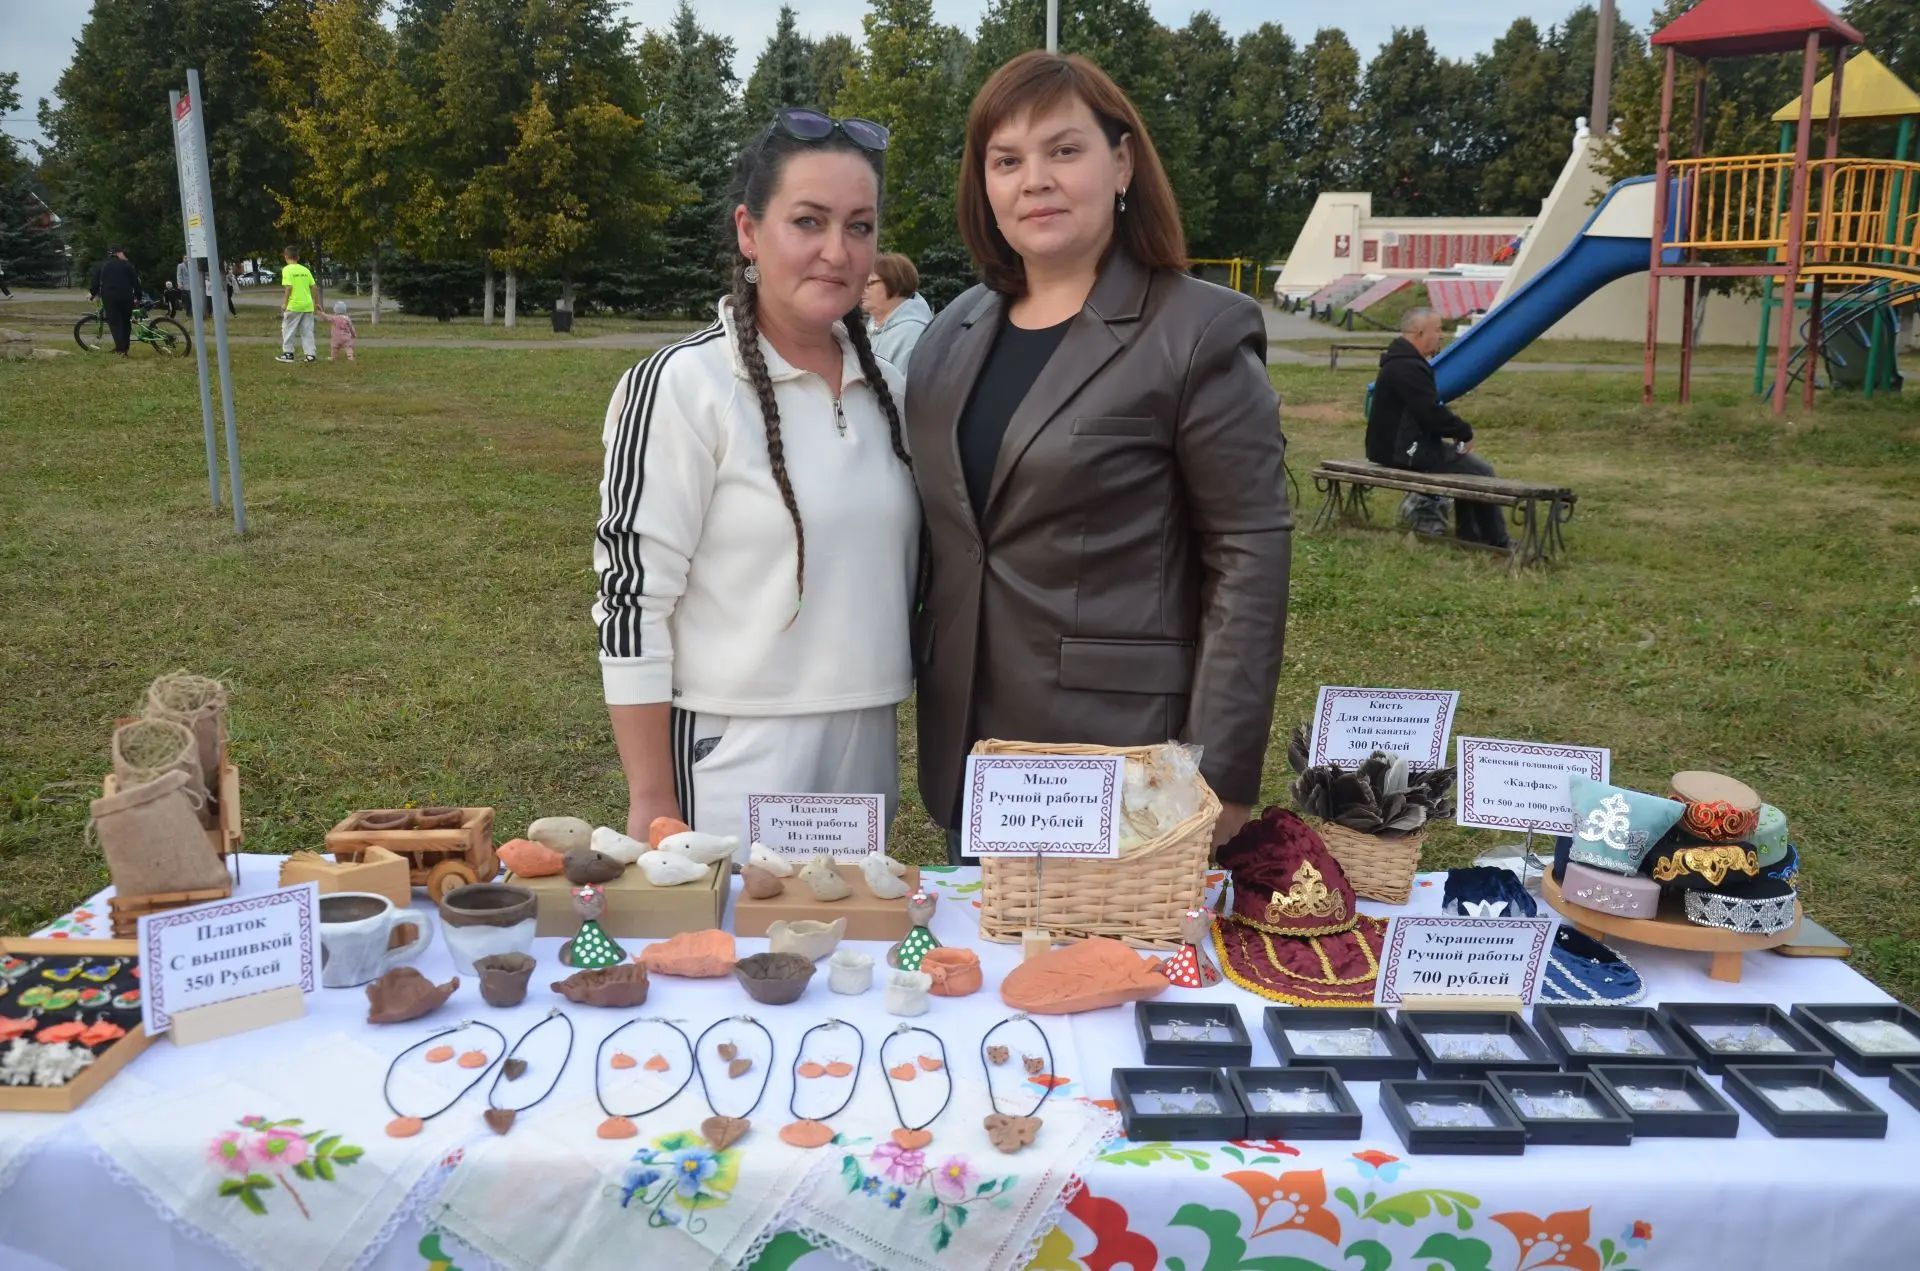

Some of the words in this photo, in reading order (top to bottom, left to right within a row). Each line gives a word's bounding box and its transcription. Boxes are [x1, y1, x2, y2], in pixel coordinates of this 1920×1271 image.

[1369, 701, 1403, 710] Кисть
[1336, 713, 1358, 722] Для
[1362, 715, 1430, 724] смазывания
[1346, 726, 1373, 735] «Май
[1375, 728, 1417, 736] канаты»
[1348, 741, 1367, 750] 300
[1371, 741, 1410, 751] Рублей
[1478, 756, 1519, 767] Женский
[1522, 762, 1564, 771] головной
[1566, 766, 1587, 774] убор
[1023, 774, 1067, 785] Мыло
[1504, 778, 1558, 790] «Калфак»
[989, 791, 1041, 805] Ручной
[1047, 793, 1098, 806] работы
[1483, 797, 1494, 805] От
[1528, 802, 1547, 810] 1000
[791, 805, 838, 814] Изделия
[771, 818, 813, 828] Ручной
[817, 819, 858, 829] работы
[1001, 814, 1026, 827] 200
[1031, 814, 1084, 830] Рублей
[788, 832, 802, 840] Из
[832, 847, 866, 855] рублей
[197, 917, 267, 941] Платок
[1425, 933, 1515, 945] Украшения
[170, 955, 185, 971] С
[192, 933, 293, 967] вышивкой
[1407, 949, 1463, 962] Ручной
[1467, 950, 1524, 963] работы
[184, 974, 214, 993] 350
[220, 961, 281, 986] Рублей
[1412, 971, 1442, 984] 700
[1446, 971, 1509, 988] рублей
